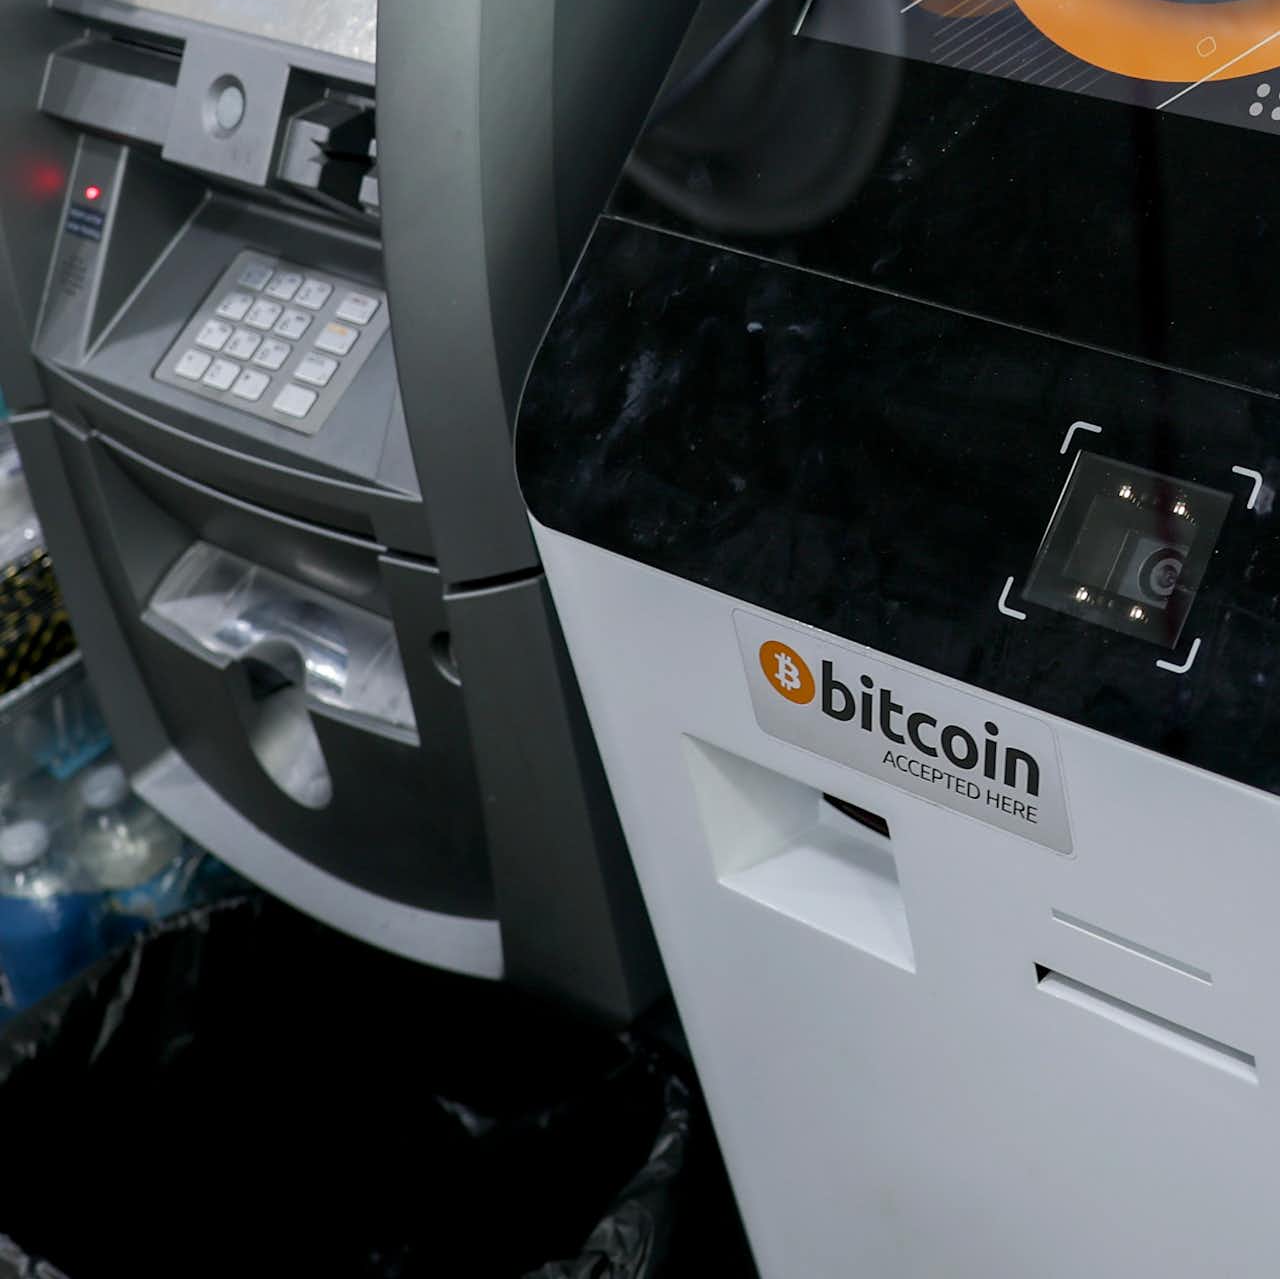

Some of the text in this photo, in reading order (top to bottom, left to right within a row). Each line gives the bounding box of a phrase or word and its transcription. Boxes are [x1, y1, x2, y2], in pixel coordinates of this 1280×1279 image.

[821, 660, 1041, 798] bitcoin
[882, 750, 1039, 824] ACCEPTED HERE
